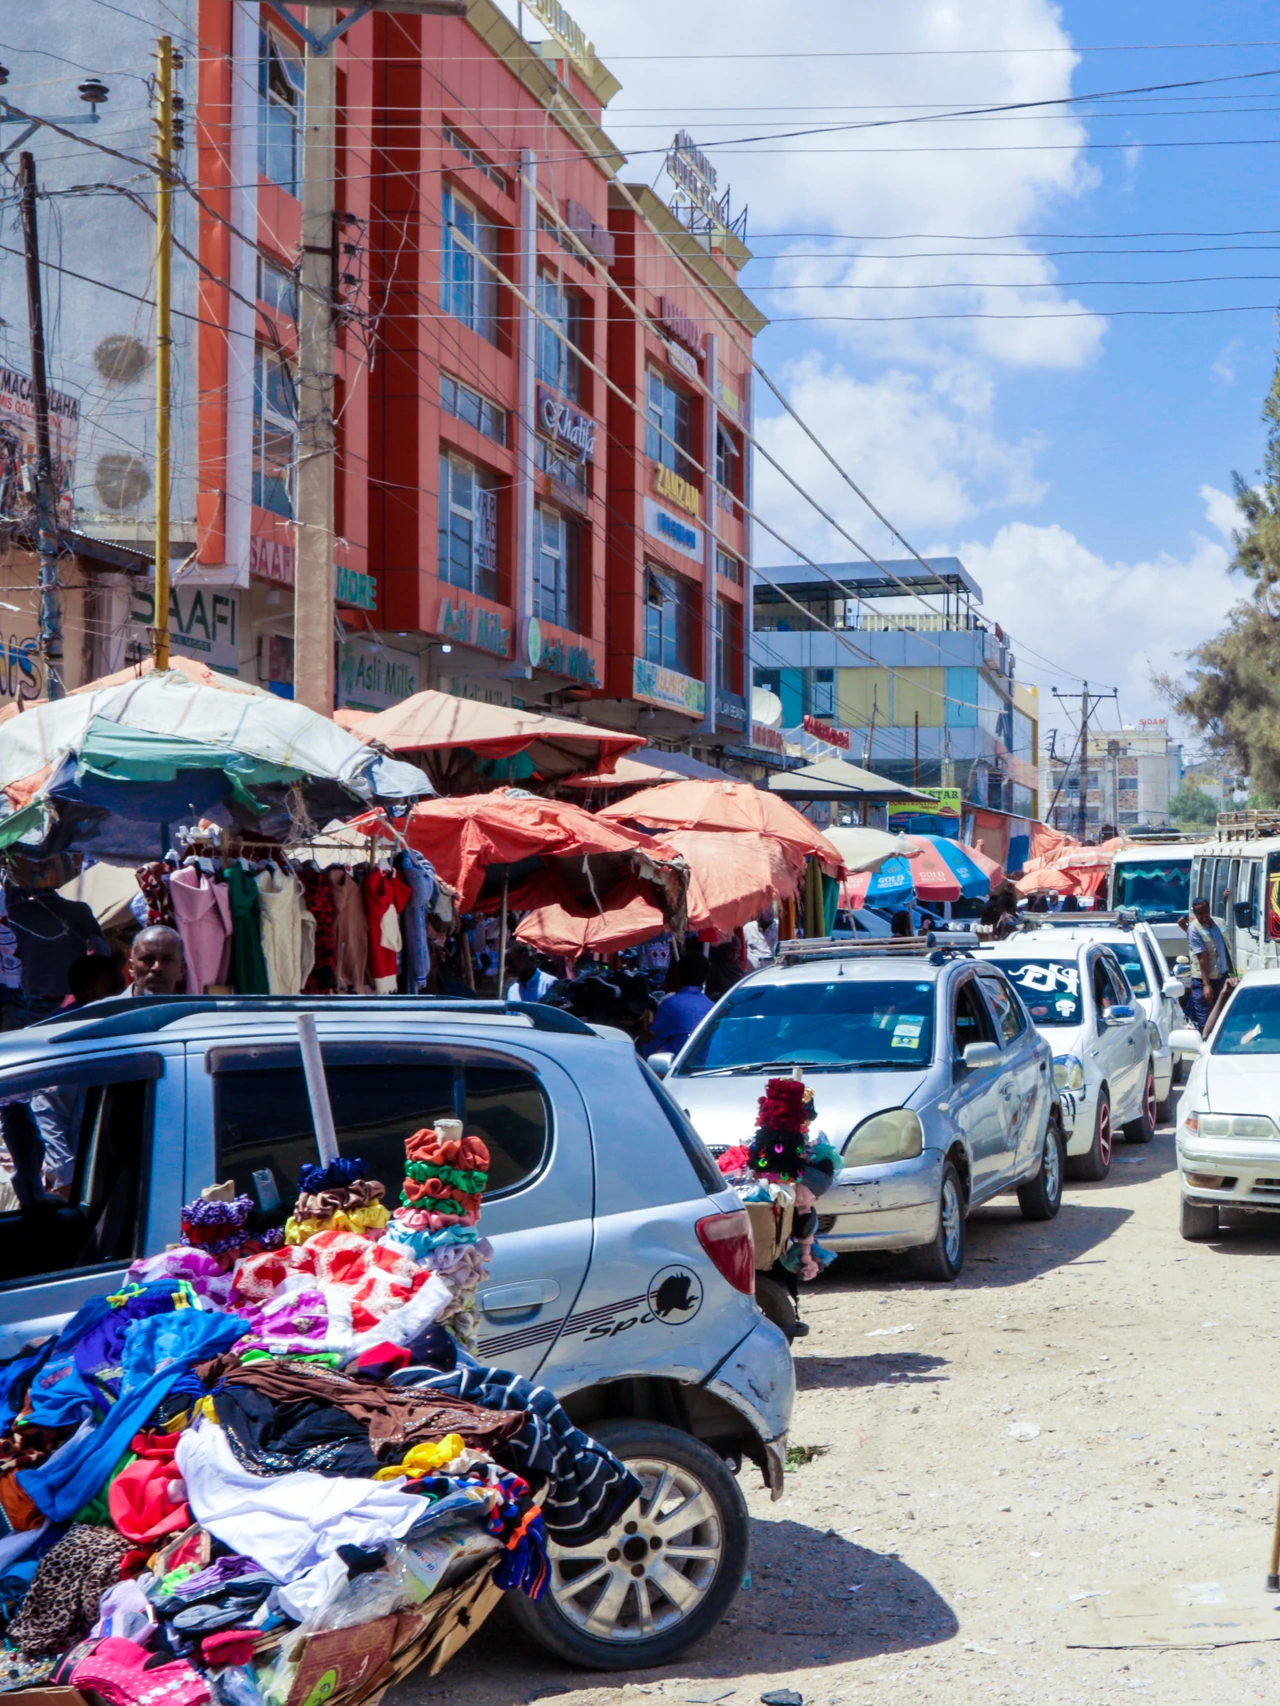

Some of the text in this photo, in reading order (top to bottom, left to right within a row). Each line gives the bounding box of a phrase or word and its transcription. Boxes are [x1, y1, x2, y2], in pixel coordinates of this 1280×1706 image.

[131, 586, 236, 645] SAAFI
[356, 654, 415, 697] Asli Mills
[877, 875, 904, 884] GOLD
